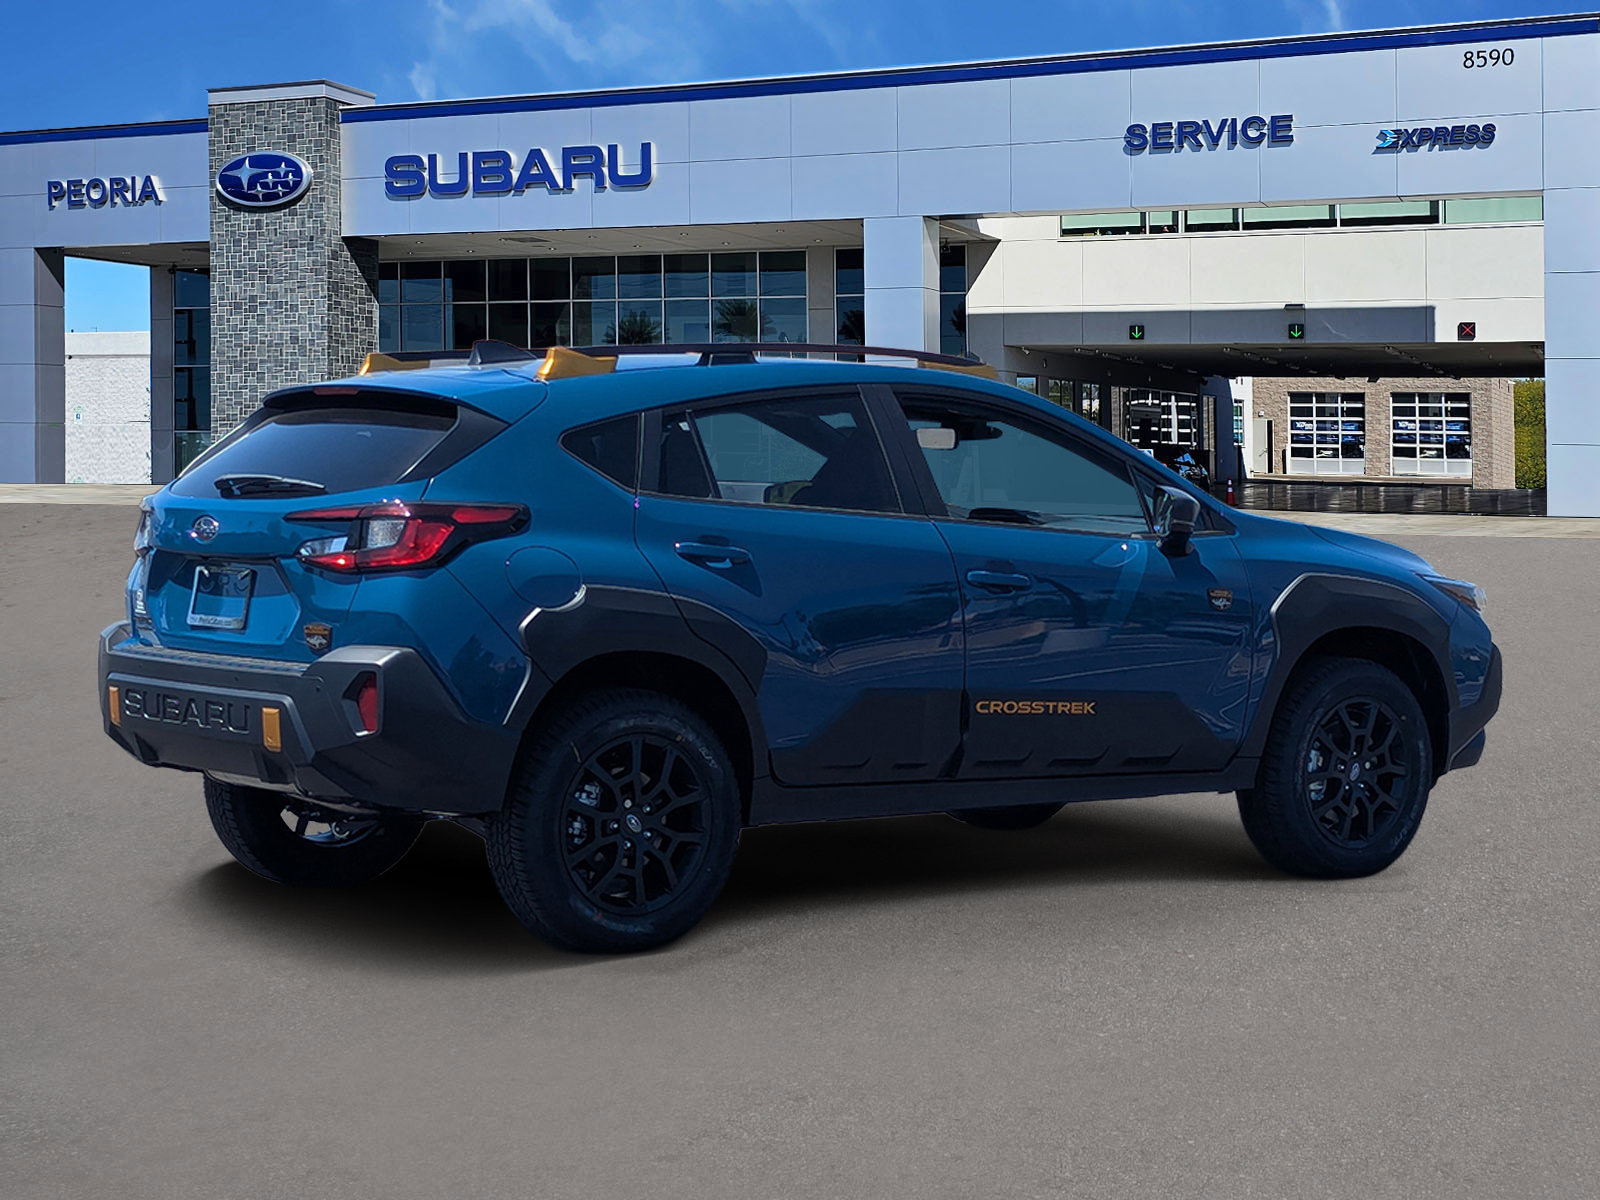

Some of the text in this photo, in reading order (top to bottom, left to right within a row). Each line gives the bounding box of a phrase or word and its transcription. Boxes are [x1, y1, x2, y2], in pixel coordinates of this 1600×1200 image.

[1463, 48, 1514, 69] 8590
[1124, 114, 1294, 153] SERVICE
[1376, 123, 1496, 151] EXPRESS
[384, 142, 653, 199] SUBARU
[47, 175, 163, 210] PEORIA
[124, 688, 250, 734] SUBARU
[975, 700, 1096, 715] CROSSTREK
